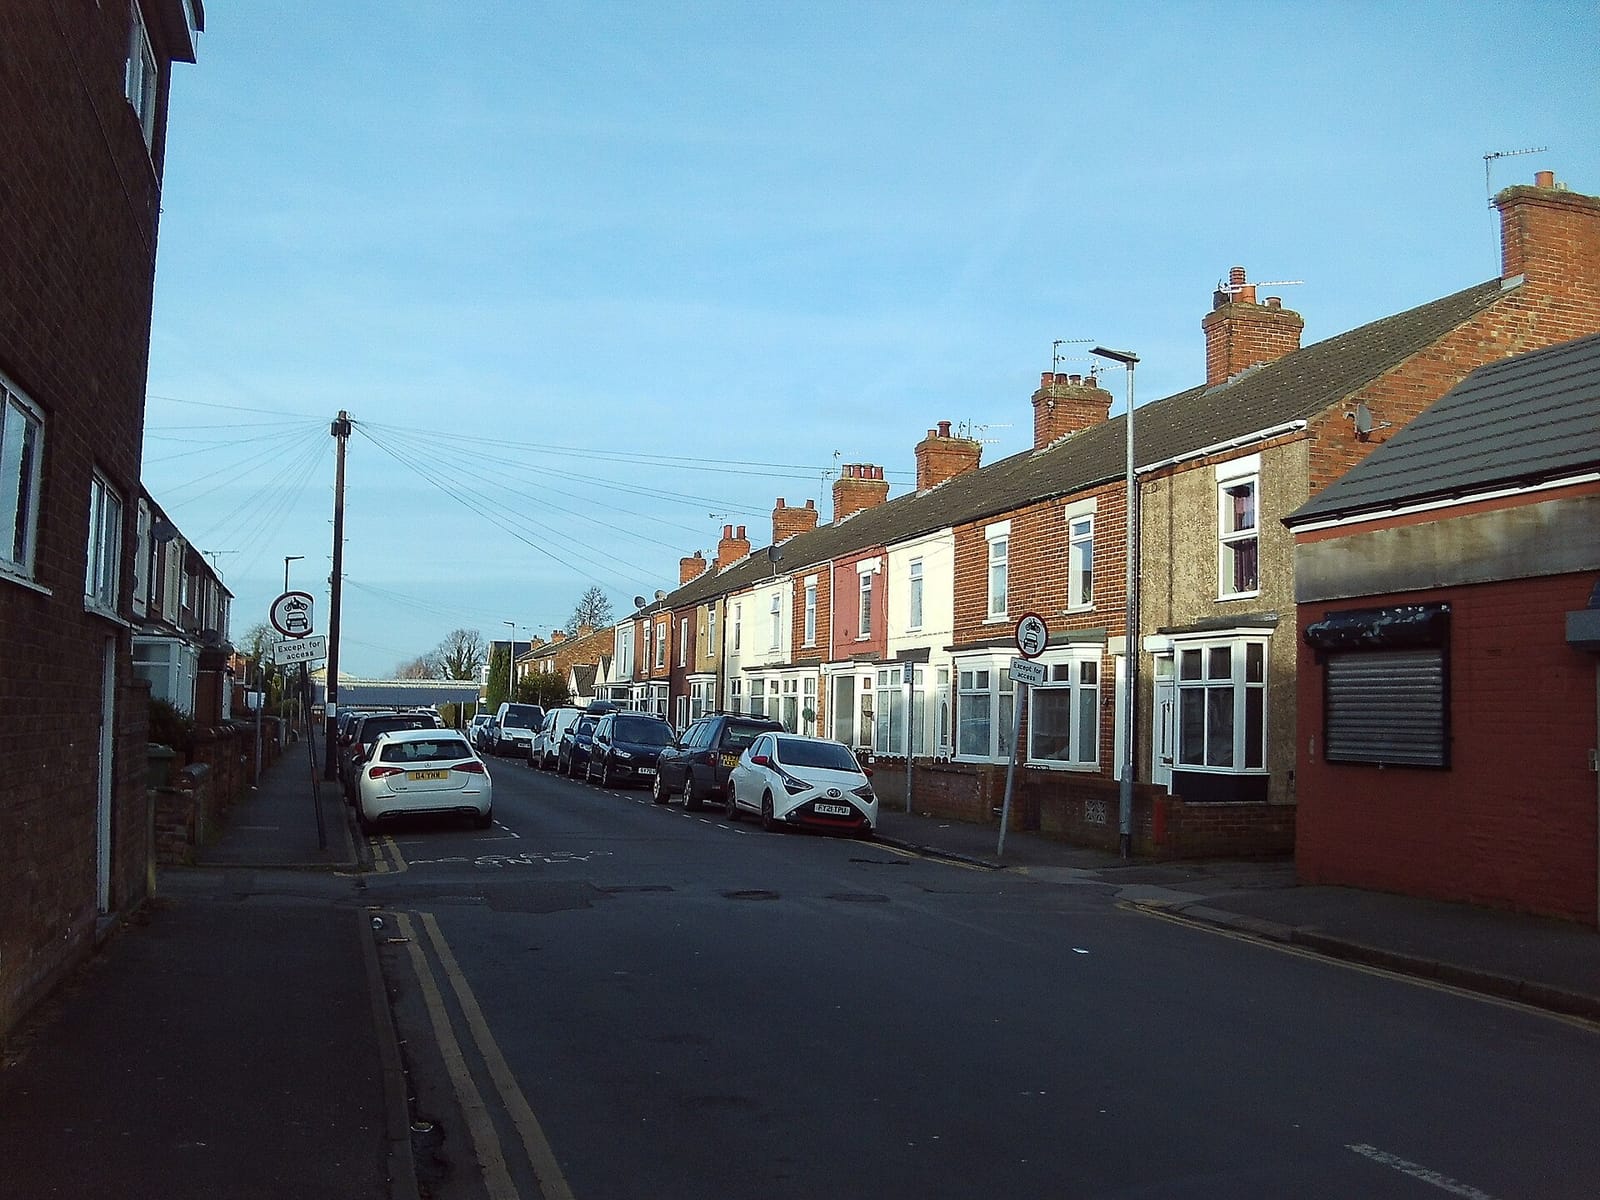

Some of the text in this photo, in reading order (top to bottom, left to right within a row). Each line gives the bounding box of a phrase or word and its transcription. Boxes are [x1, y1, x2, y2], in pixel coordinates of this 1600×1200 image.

[278, 643, 305, 652] Except
[287, 651, 314, 660] access
[1013, 661, 1042, 674] Except for
[1017, 672, 1036, 681] access
